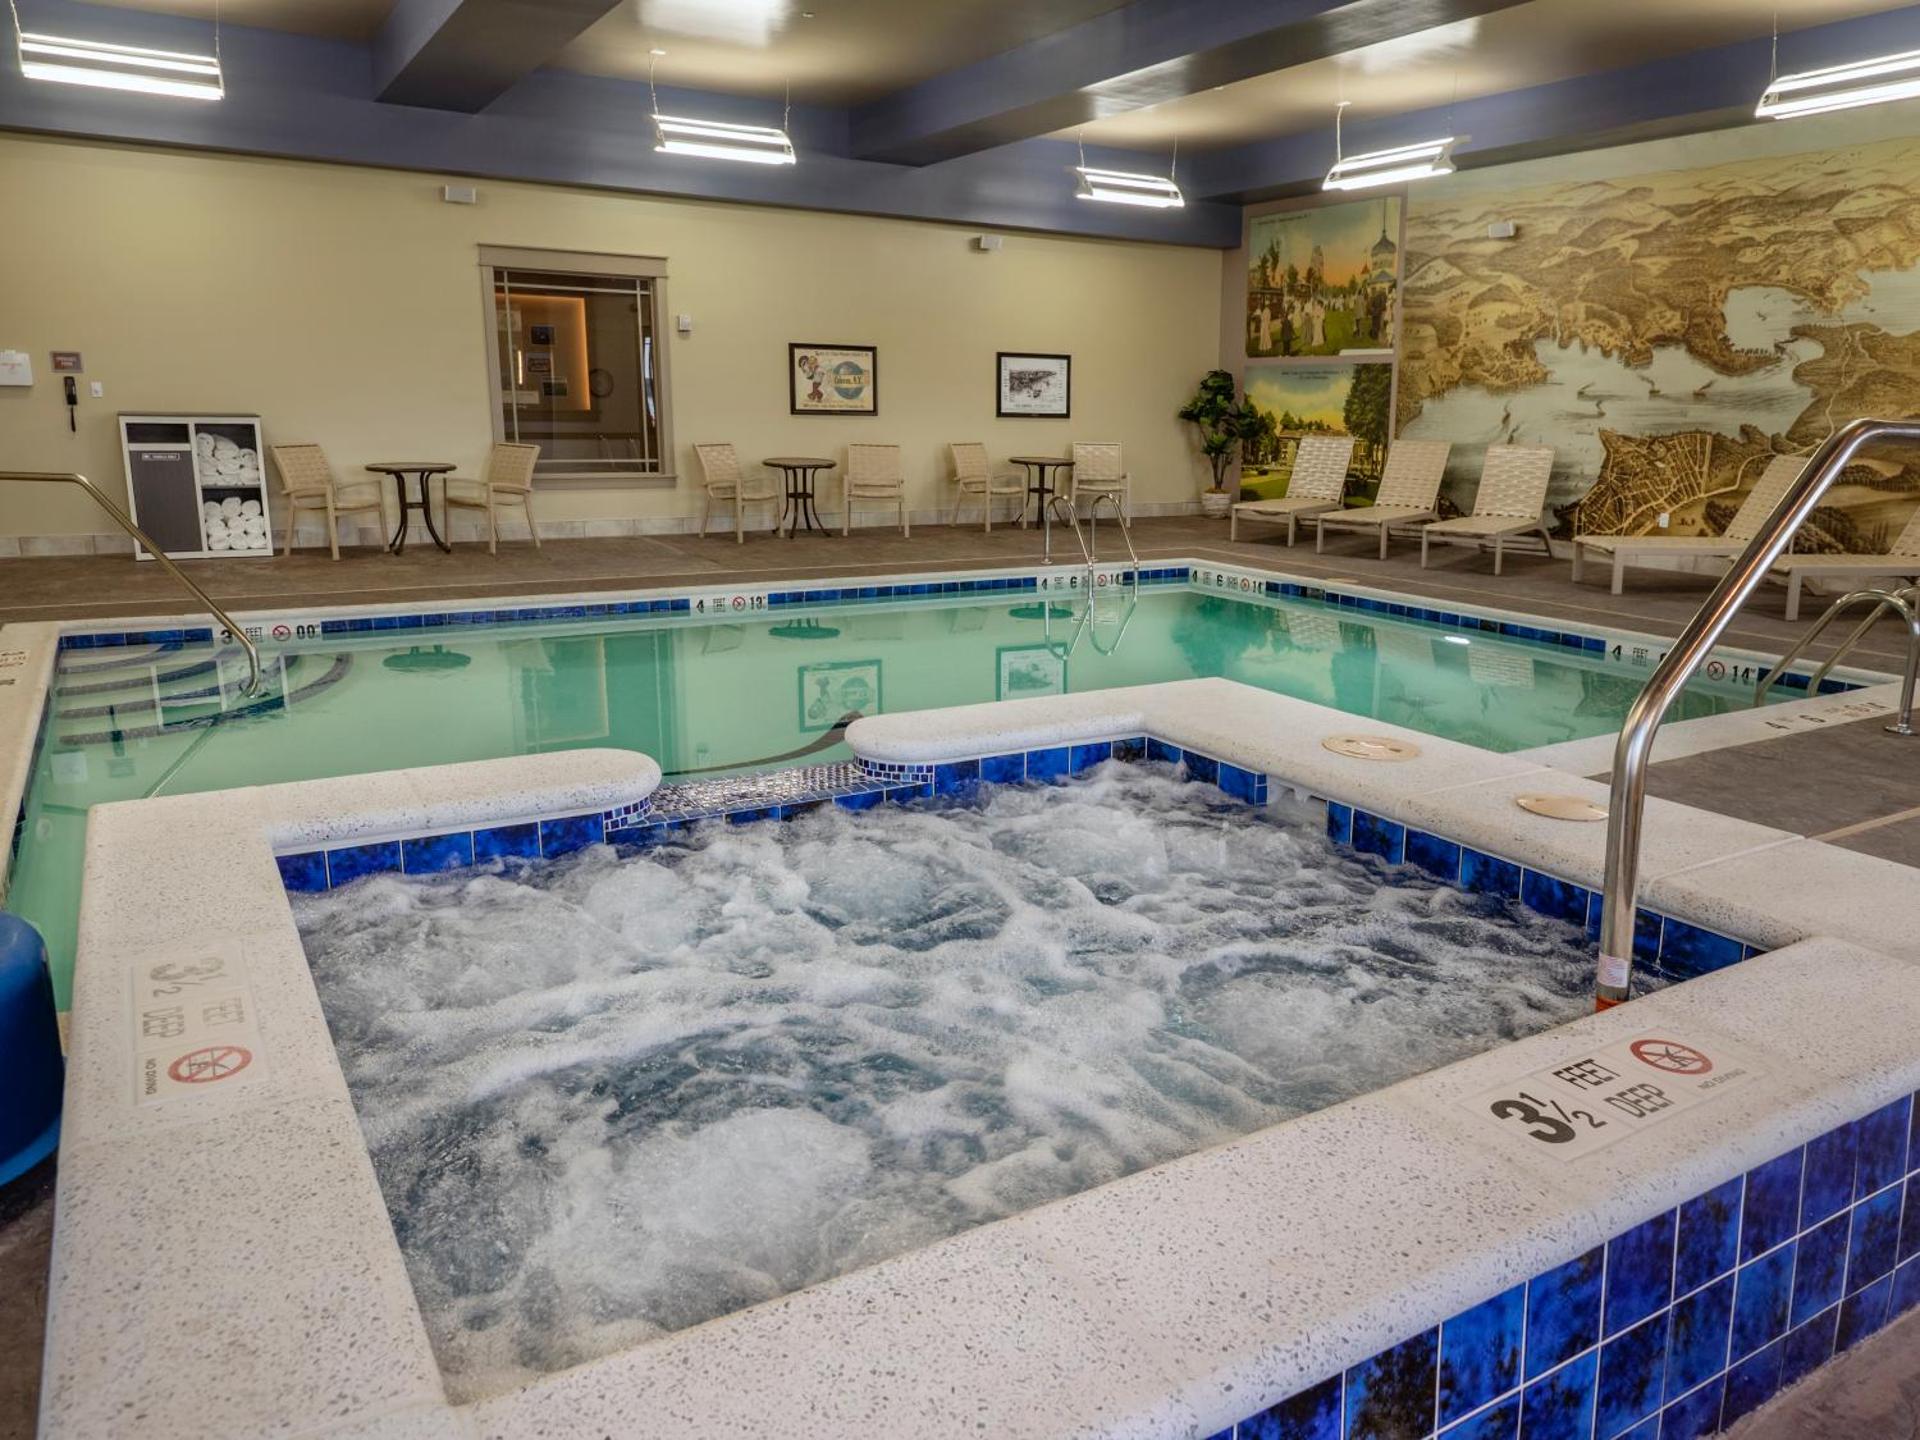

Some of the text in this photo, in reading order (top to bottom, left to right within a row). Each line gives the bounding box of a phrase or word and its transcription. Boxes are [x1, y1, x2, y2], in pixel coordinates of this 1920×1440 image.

[142, 1006, 186, 1039] DEEP
[1552, 1058, 1621, 1090] FEET
[1602, 1083, 1675, 1119] DEEP
